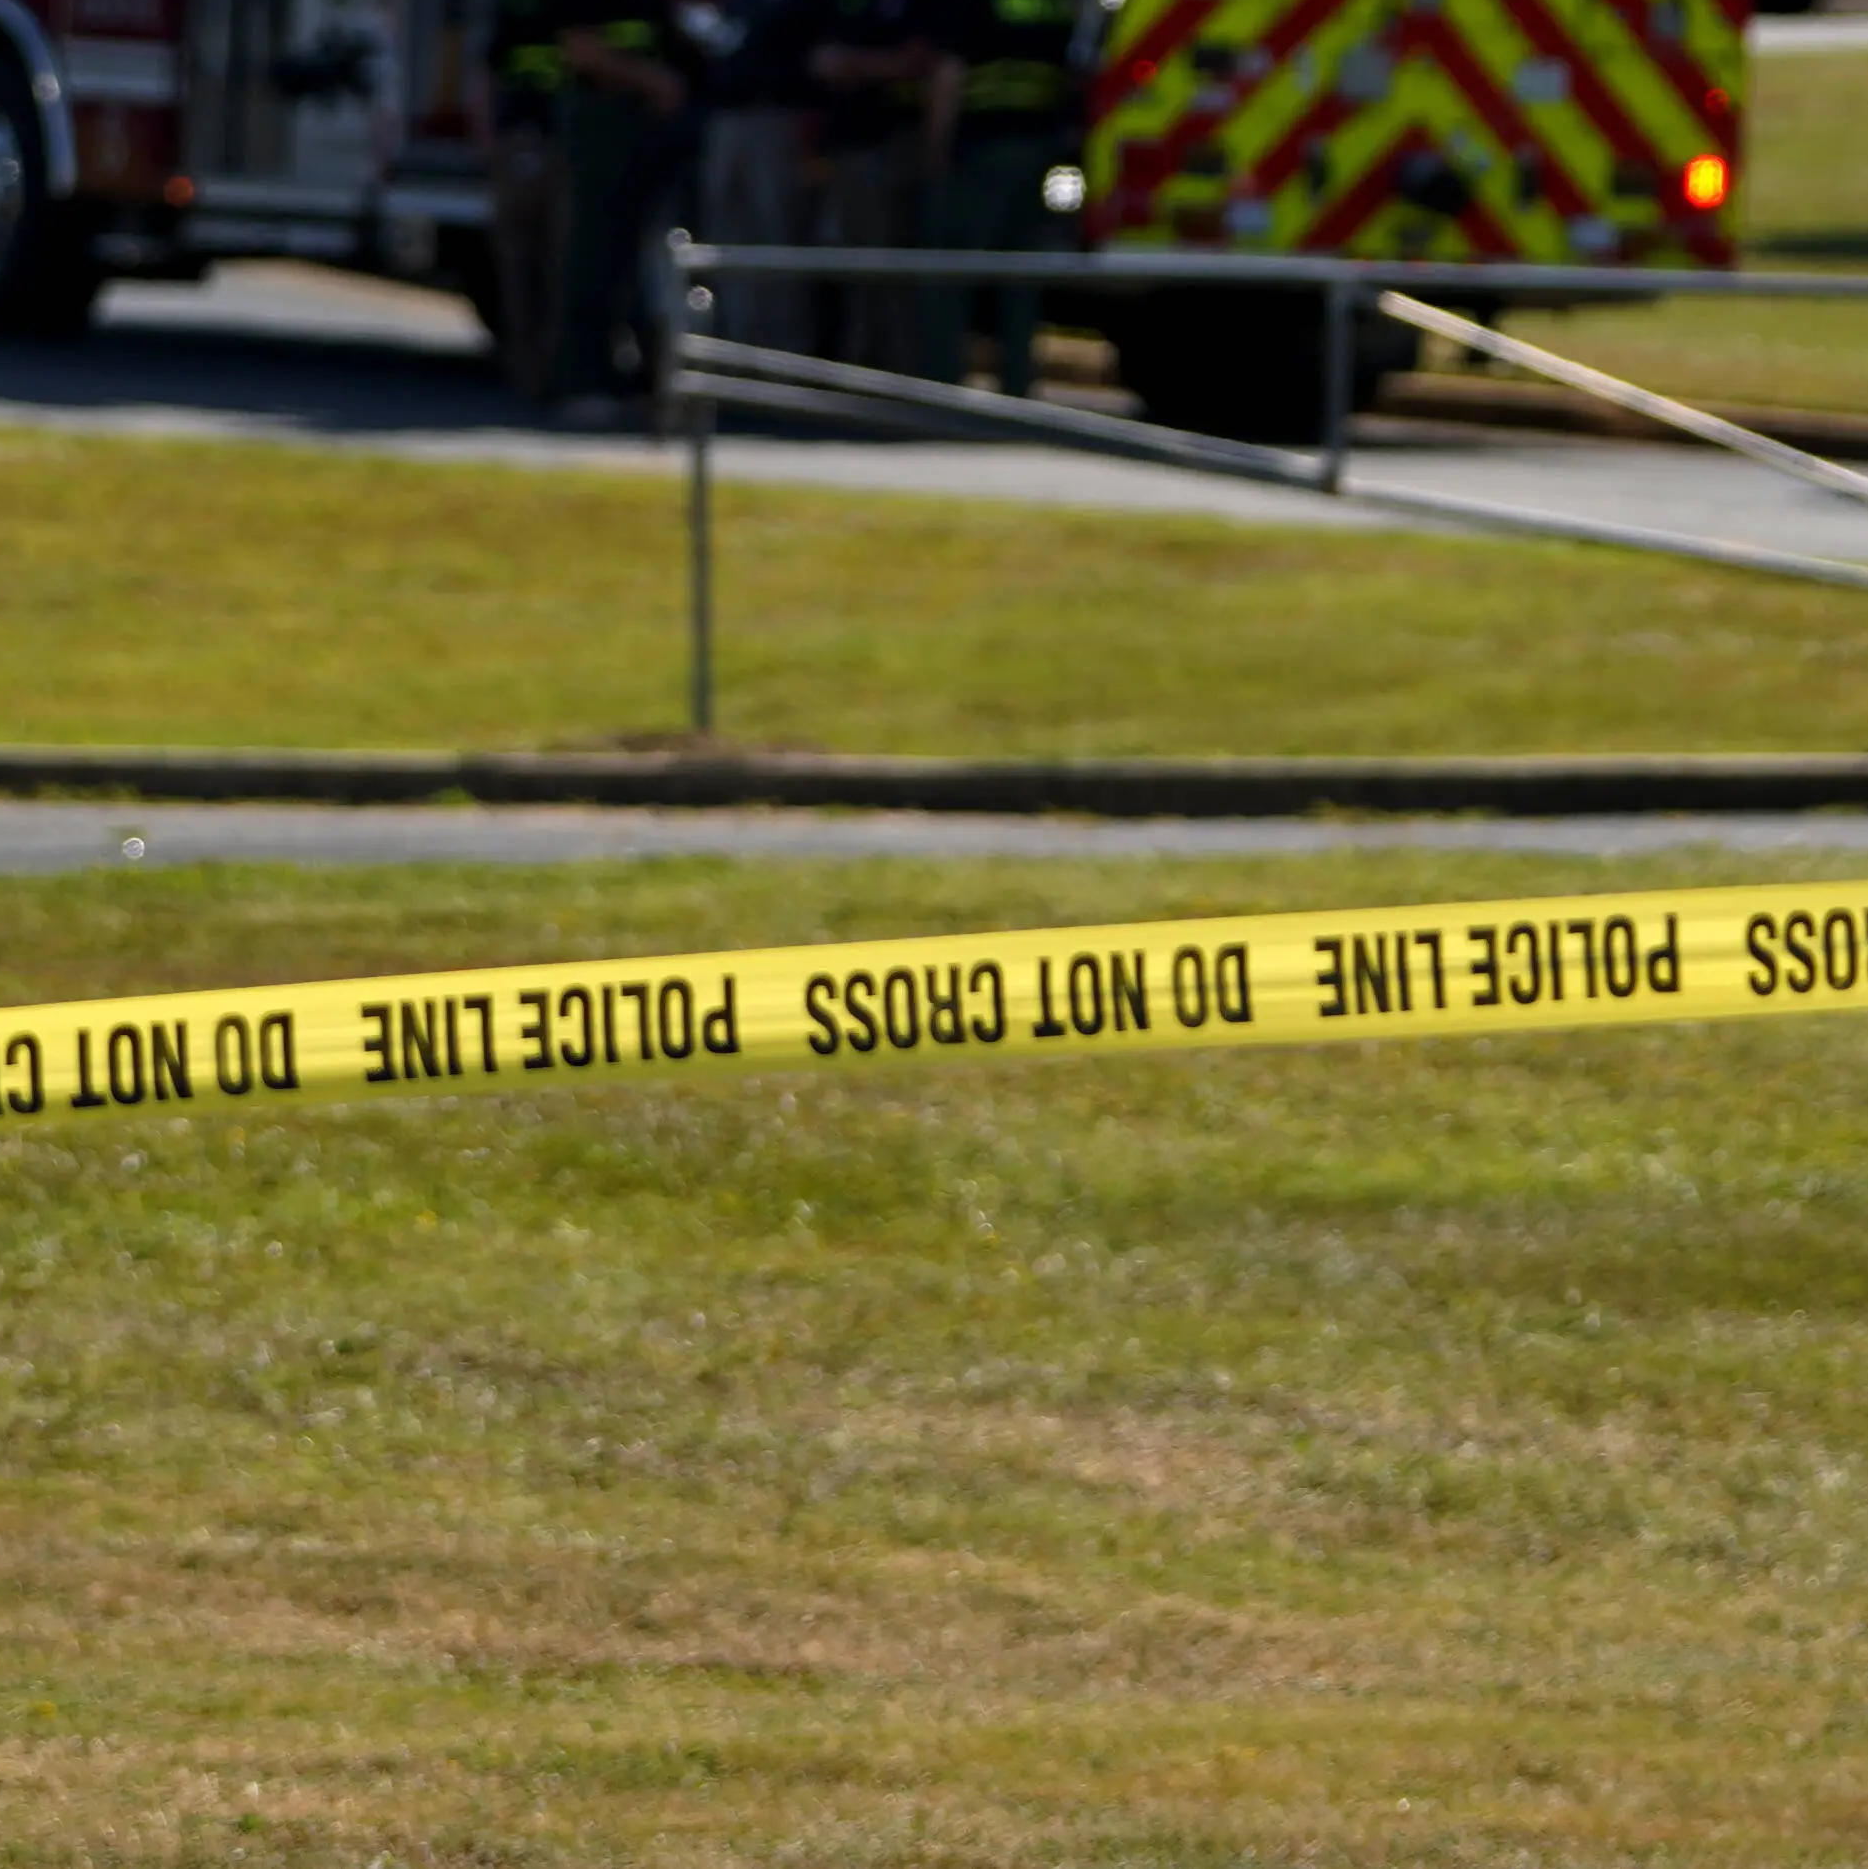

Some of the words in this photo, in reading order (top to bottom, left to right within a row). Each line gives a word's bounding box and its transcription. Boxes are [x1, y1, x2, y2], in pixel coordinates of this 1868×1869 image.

[1032, 953, 1150, 1039] NOT
[1173, 945, 1253, 1029] DO
[1315, 932, 1446, 1018] LINE
[1468, 916, 1680, 1007] POLICE
[361, 997, 501, 1086] LINE
[519, 977, 742, 1075] POLICE
[805, 962, 1007, 1059] CROSS
[68, 1023, 196, 1112] NOT
[215, 1013, 302, 1099] DO
